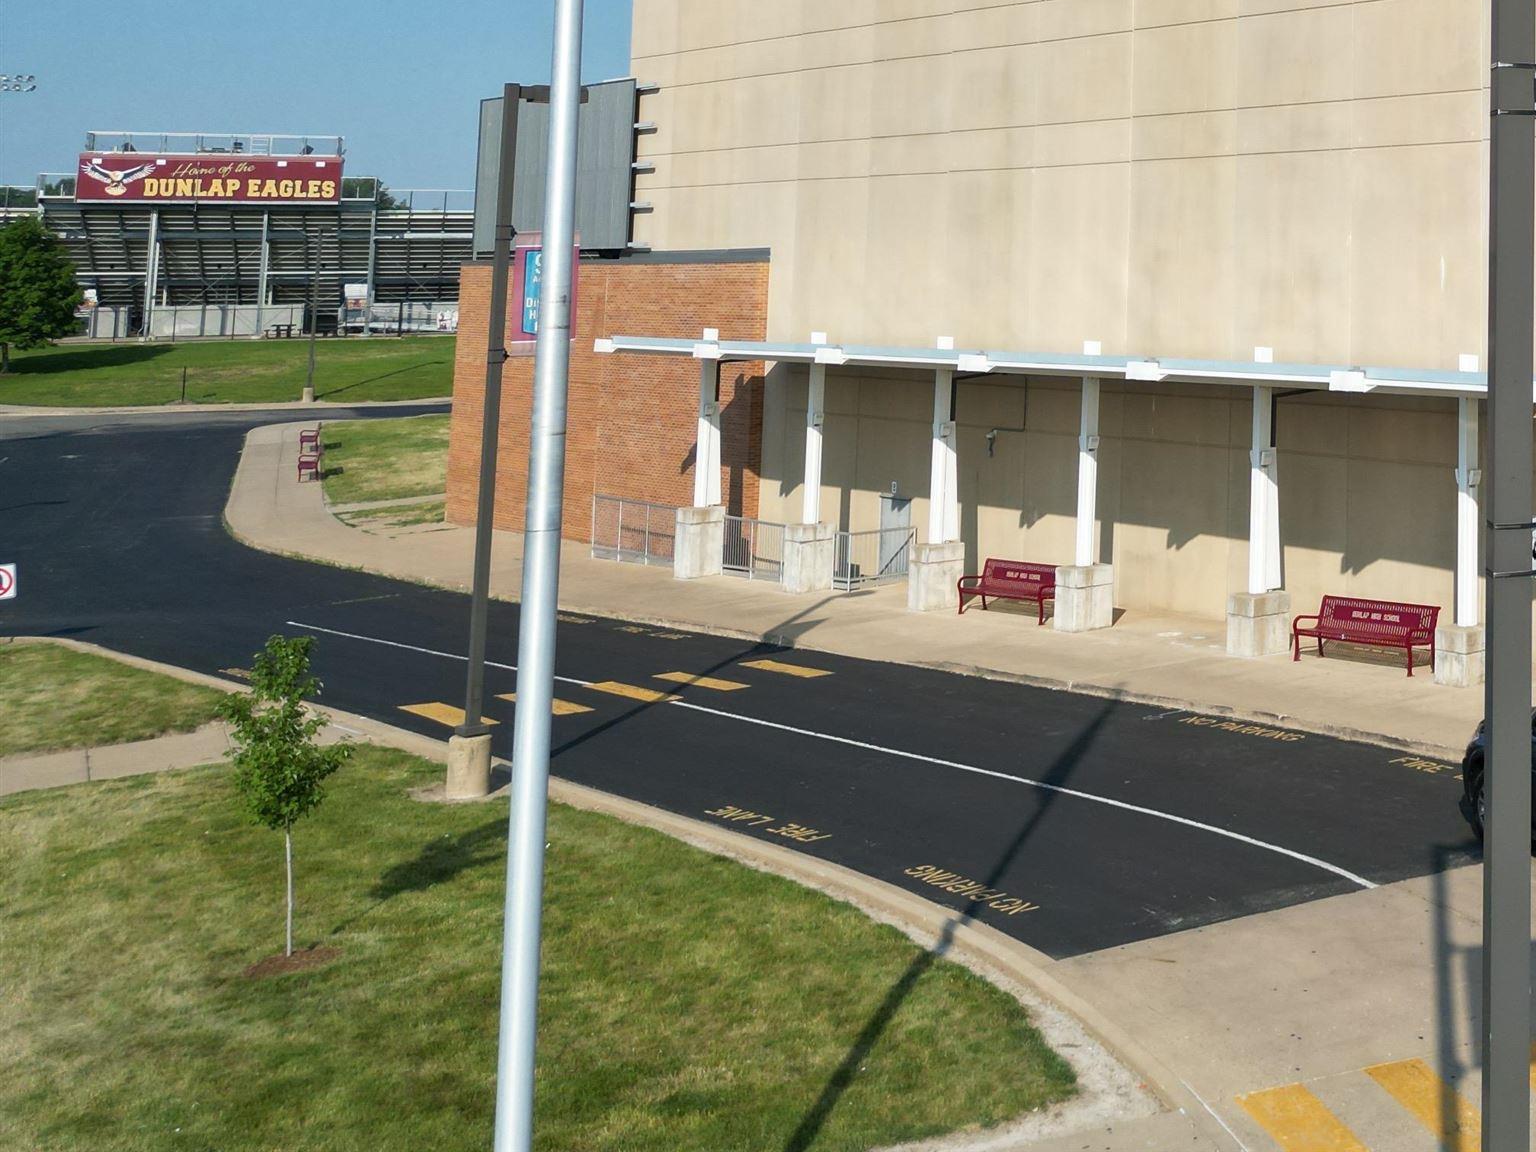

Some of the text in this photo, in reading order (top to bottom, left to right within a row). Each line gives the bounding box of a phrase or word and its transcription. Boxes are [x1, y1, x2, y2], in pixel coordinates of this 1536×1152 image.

[171, 161, 257, 179] Home of the
[143, 178, 336, 199] DUNLAP EAGLES
[1387, 756, 1455, 774] FIRE
[703, 805, 832, 842] FIRE LANE
[903, 864, 1041, 915] NO PARKING
